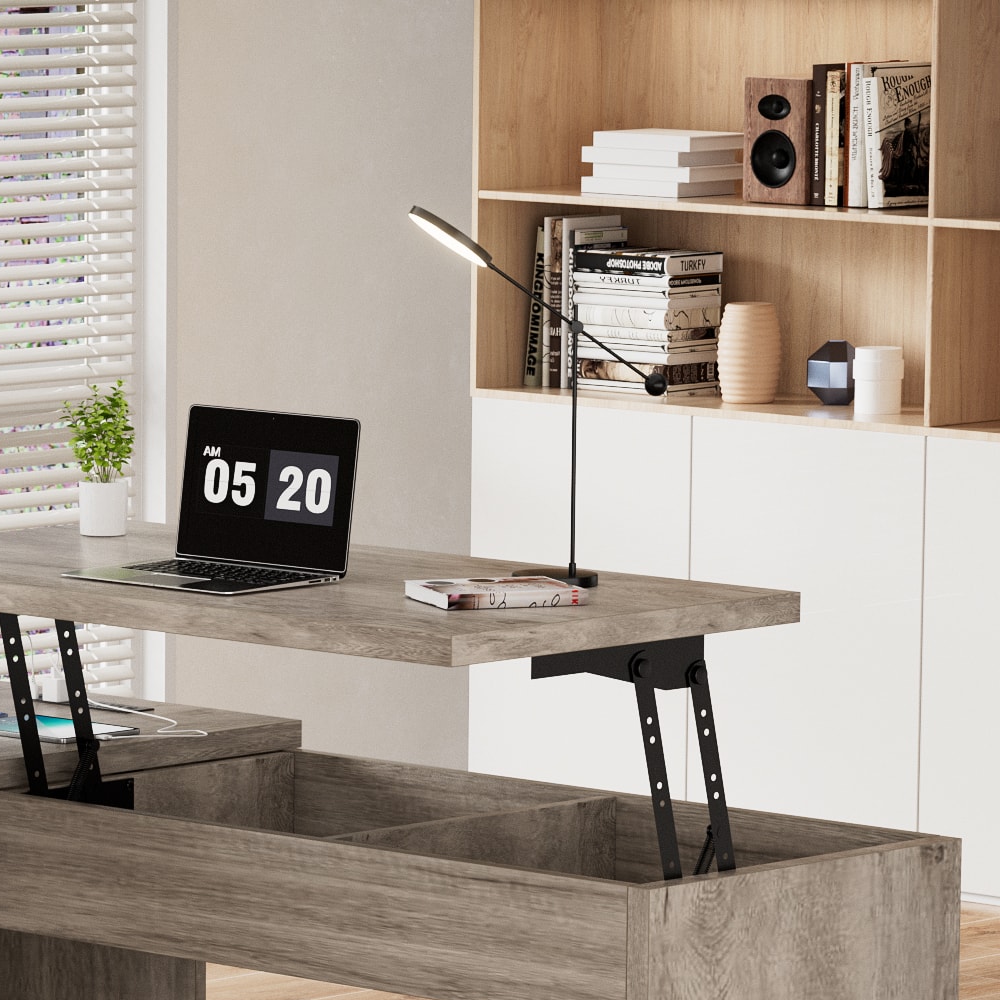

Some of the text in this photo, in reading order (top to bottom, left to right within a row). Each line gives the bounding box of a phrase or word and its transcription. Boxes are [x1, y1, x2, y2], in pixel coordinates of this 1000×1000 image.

[895, 75, 931, 103] ENOUGH
[606, 258, 663, 271] ADOBE PHOTOSHOP
[203, 445, 221, 458] AM
[203, 458, 332, 514] 05 20
